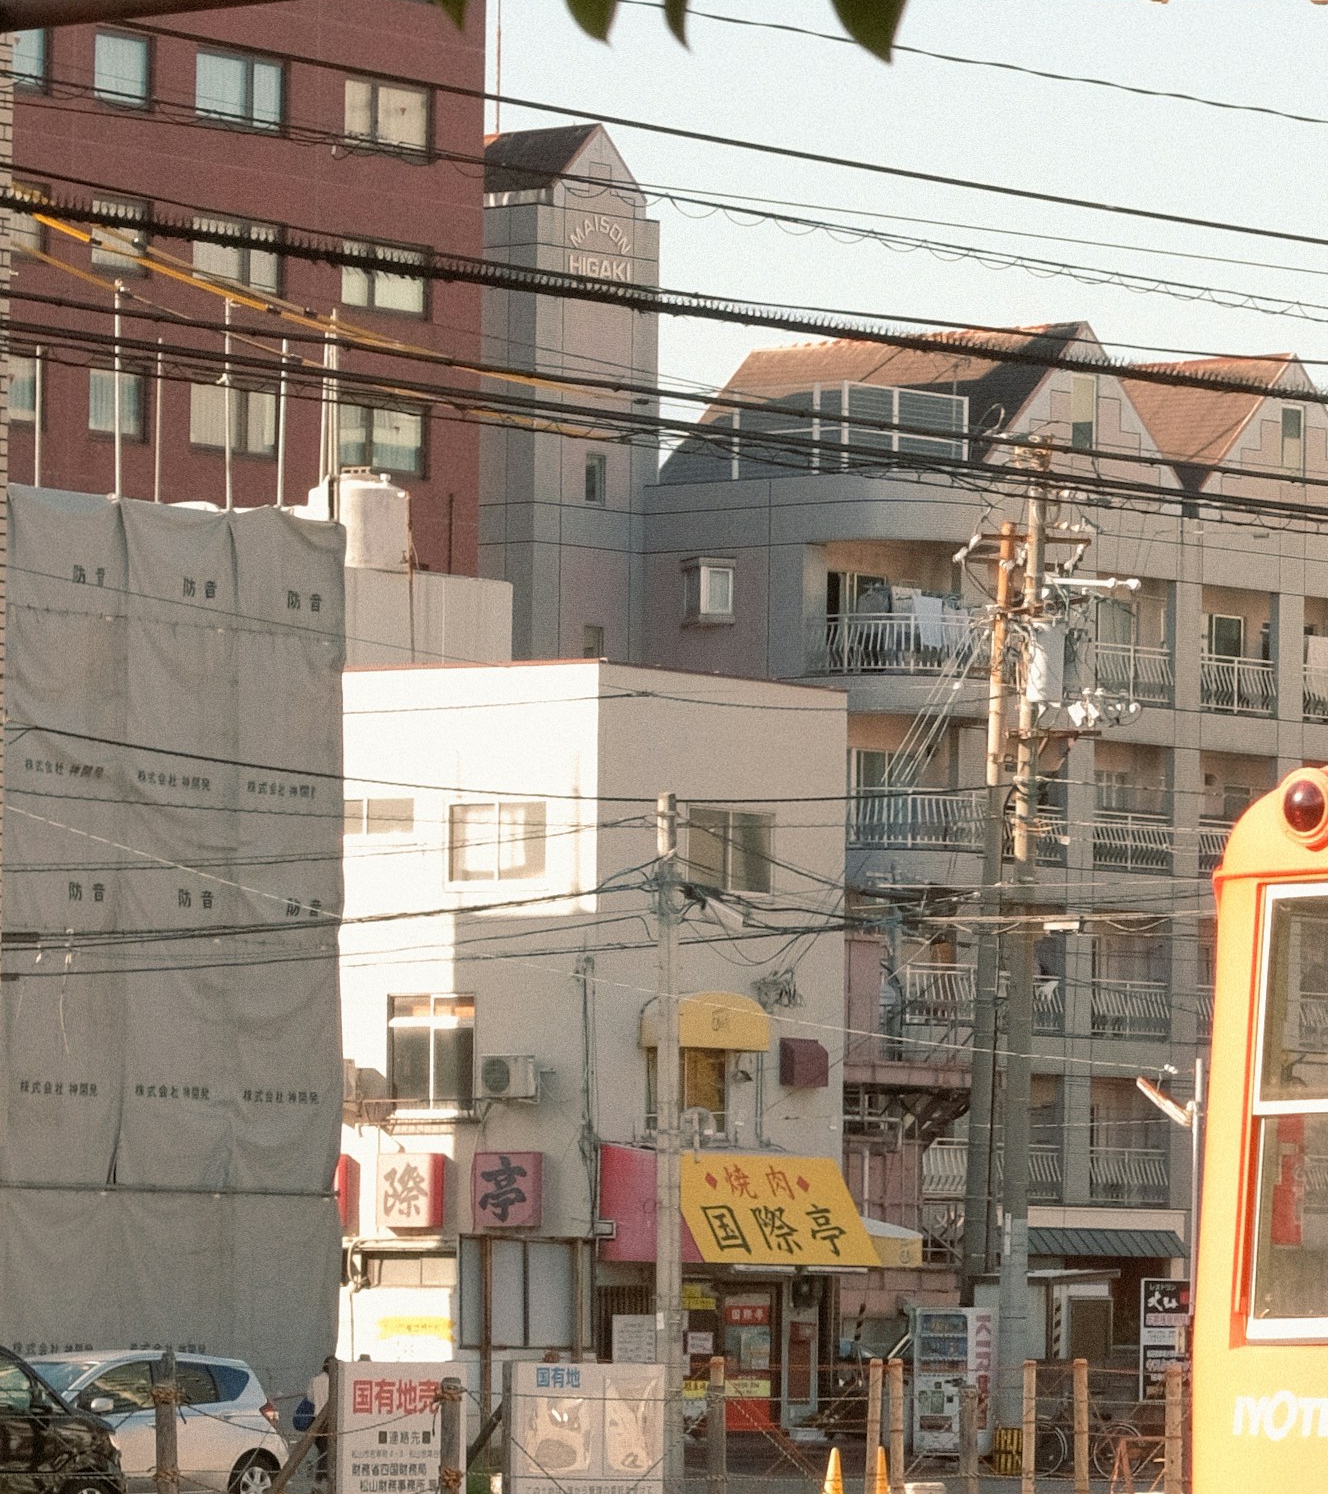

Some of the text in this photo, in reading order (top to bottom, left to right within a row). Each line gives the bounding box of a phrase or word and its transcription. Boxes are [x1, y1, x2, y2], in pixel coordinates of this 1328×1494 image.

[569, 214, 632, 255] MAISON
[568, 254, 632, 282] HIGAKI
[183, 577, 217, 599] 防音
[287, 590, 322, 612] 防音
[68, 881, 106, 903] 防音
[178, 888, 215, 910] 防音
[723, 1163, 796, 1200] 焼肉
[701, 1203, 847, 1257] 国際亭
[536, 1366, 581, 1388] 国有地
